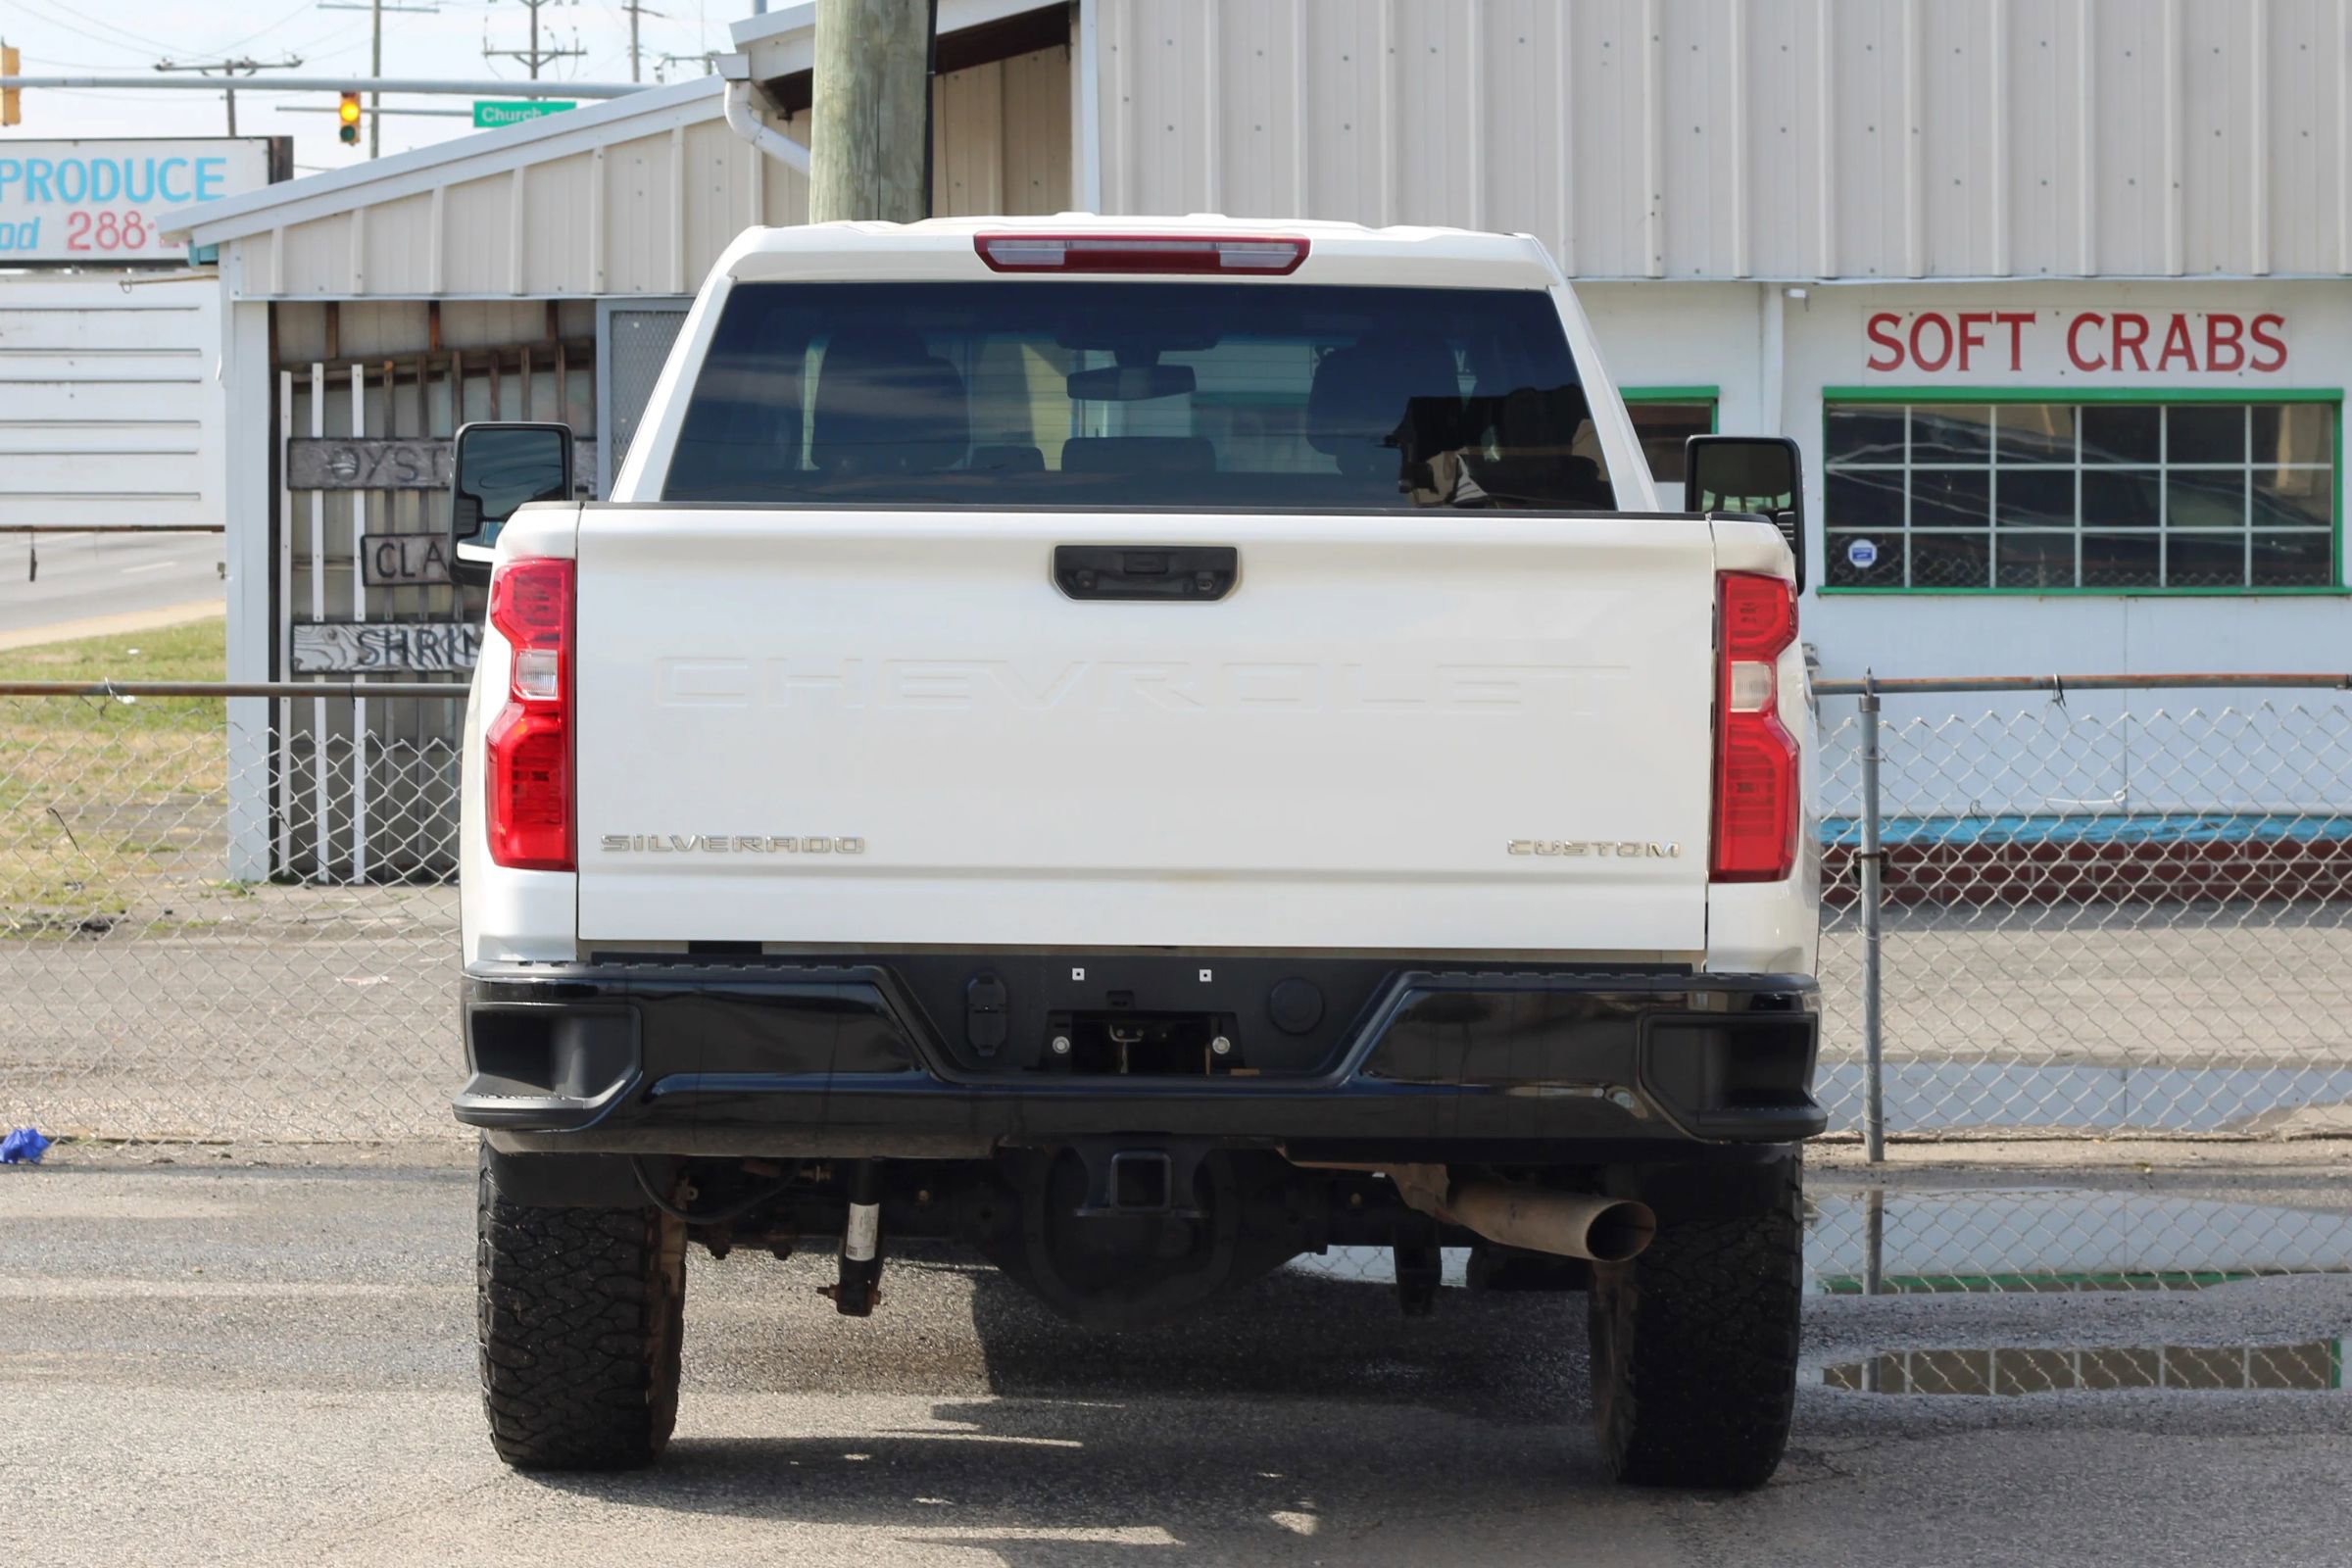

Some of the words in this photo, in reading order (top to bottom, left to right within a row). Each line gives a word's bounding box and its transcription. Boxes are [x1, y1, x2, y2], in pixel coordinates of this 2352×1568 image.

[481, 106, 542, 122] Church
[0, 157, 226, 203] PRODUCE
[1866, 311, 2036, 372] SOFT
[2066, 312, 2288, 373] CRABS
[655, 657, 1631, 716] CHEVROLET
[601, 834, 865, 854] SILVERADO
[1506, 839, 1680, 858] CUSTOM
